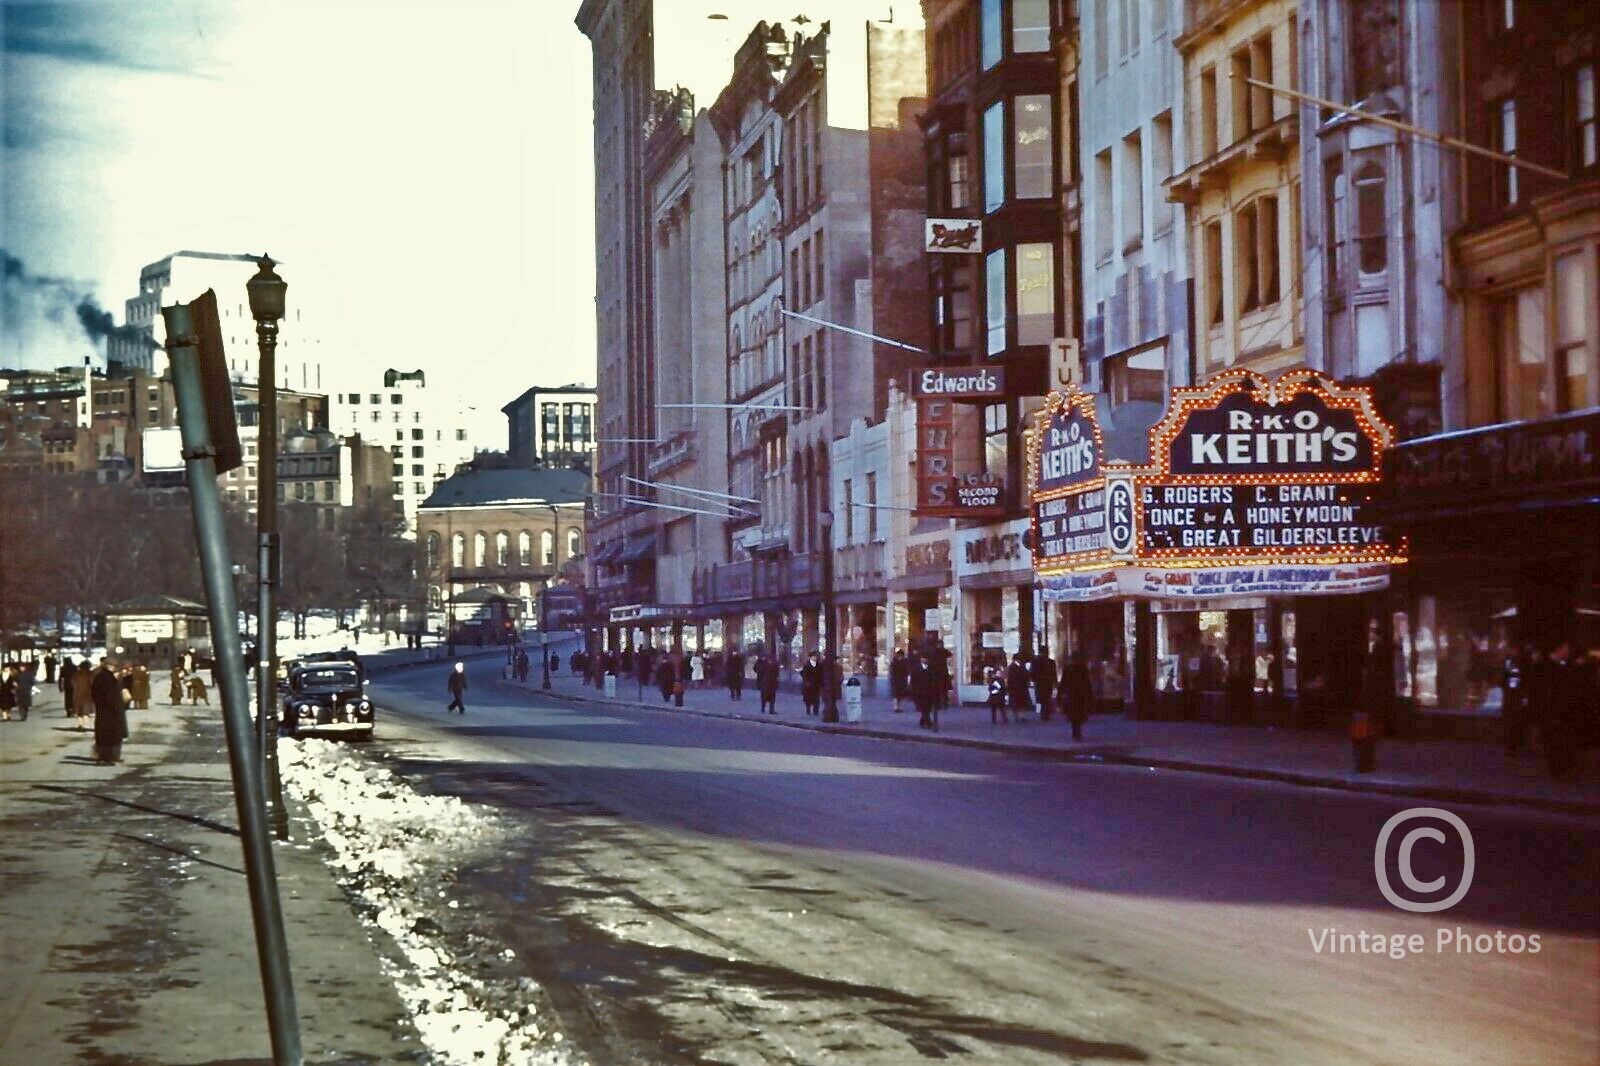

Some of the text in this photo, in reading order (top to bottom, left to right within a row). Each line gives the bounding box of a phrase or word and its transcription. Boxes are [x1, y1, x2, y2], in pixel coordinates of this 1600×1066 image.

[921, 369, 997, 394] Edwards
[1191, 426, 1358, 464] KEITH'S
[1041, 436, 1094, 480] KEITH'S
[1164, 487, 1233, 504] ROGERS
[1279, 485, 1336, 501] GRANT
[1113, 489, 1129, 541] RKO
[1223, 508, 1235, 524] A
[1183, 528, 1240, 547] GREAT
[1253, 526, 1384, 546] GILDERSLEEVE
